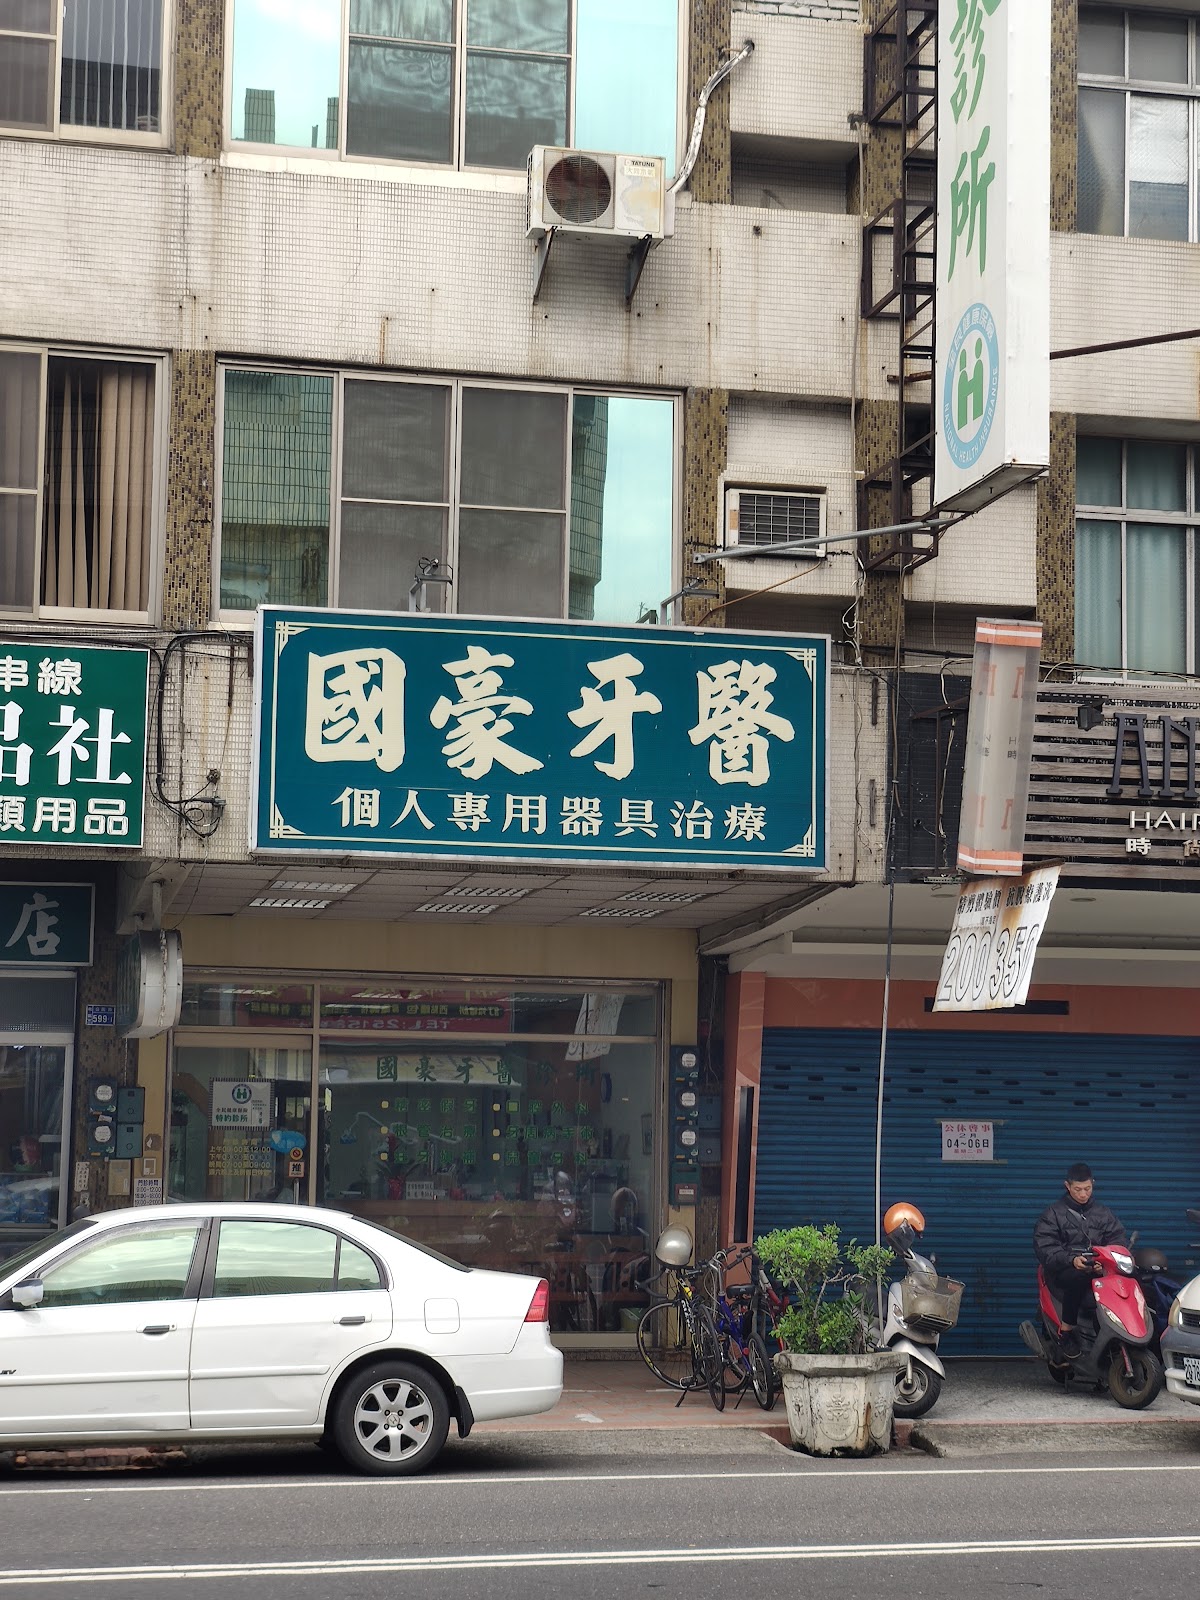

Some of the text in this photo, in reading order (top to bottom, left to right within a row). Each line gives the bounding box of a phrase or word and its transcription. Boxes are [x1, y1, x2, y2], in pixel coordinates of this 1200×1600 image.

[944, 367, 998, 463] NATIONAL HEALTH INSURANCE
[304, 645, 796, 787] 國豪牙醫
[331, 786, 768, 842] 個人專用器具治療
[5, 893, 61, 956] 店
[937, 930, 992, 1002] 200
[376, 1055, 598, 1086] 國豪牙醫診所
[215, 1114, 248, 1122] 特約診所
[137, 1179, 159, 1187] 門診時間
[291, 1163, 302, 1172] 推
